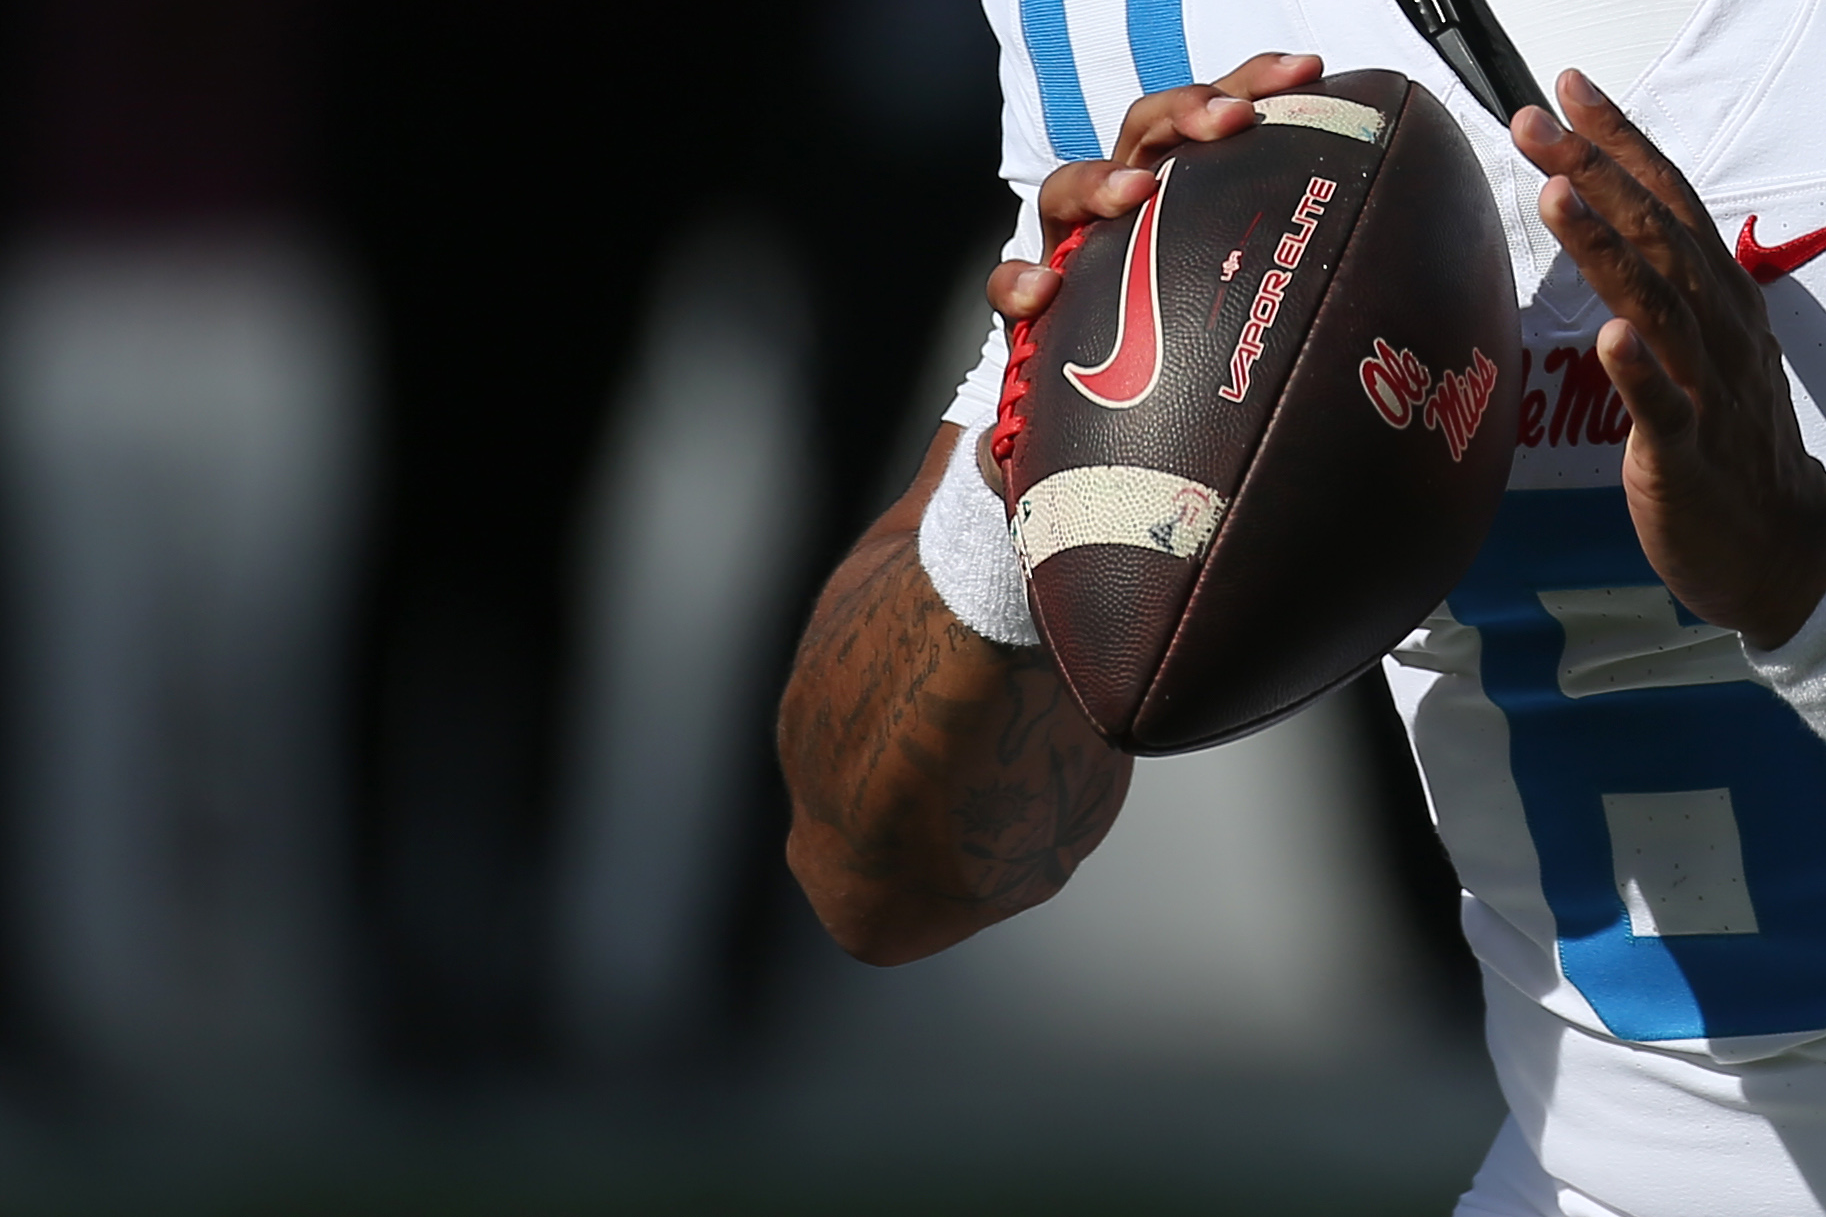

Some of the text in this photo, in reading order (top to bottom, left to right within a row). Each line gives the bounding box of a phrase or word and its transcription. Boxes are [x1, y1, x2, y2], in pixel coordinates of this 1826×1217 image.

[1218, 176, 1337, 404] VAPOR ELITE
[1360, 337, 1431, 429] Ole
[1424, 347, 1497, 462] Miss
[1544, 346, 1633, 448] Mi
